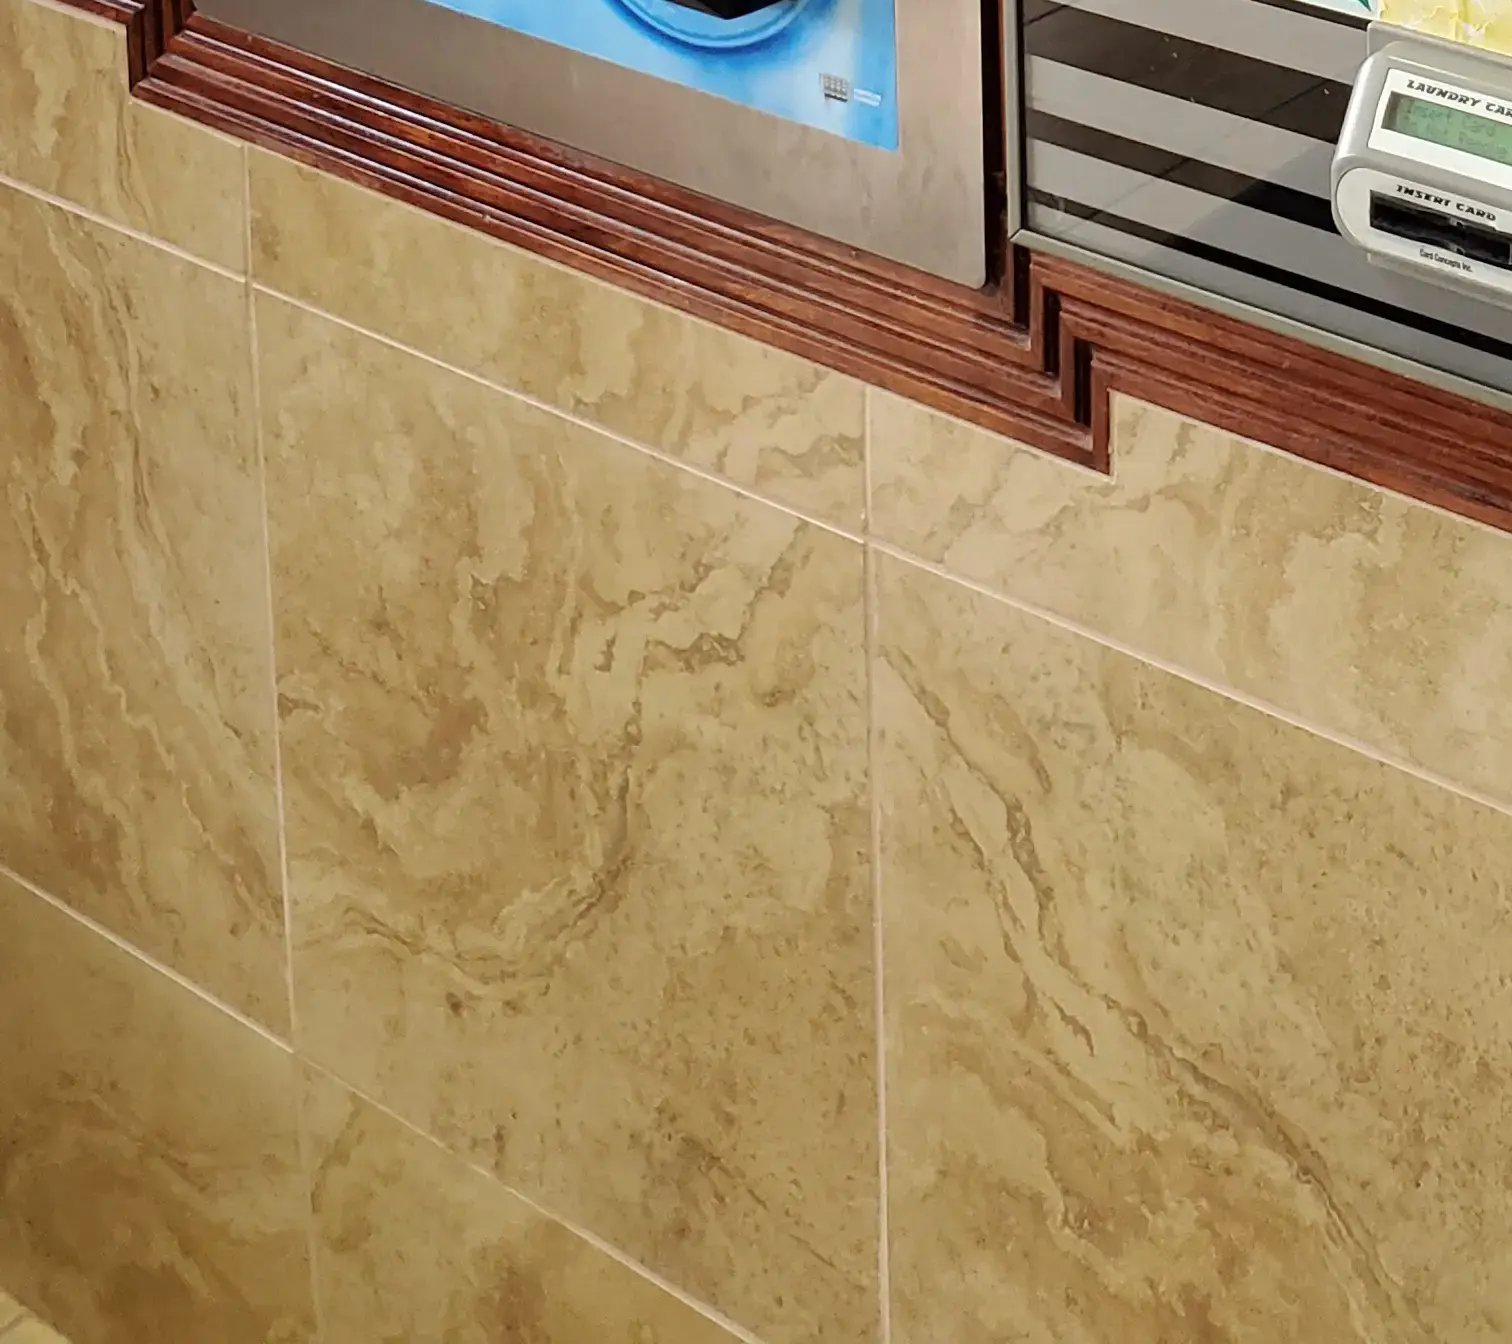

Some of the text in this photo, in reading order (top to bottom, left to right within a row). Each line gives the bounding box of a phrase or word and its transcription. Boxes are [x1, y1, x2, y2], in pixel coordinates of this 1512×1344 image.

[1406, 79, 1483, 108] LAUNDRY
[1396, 184, 1496, 221] INSERT CARD
